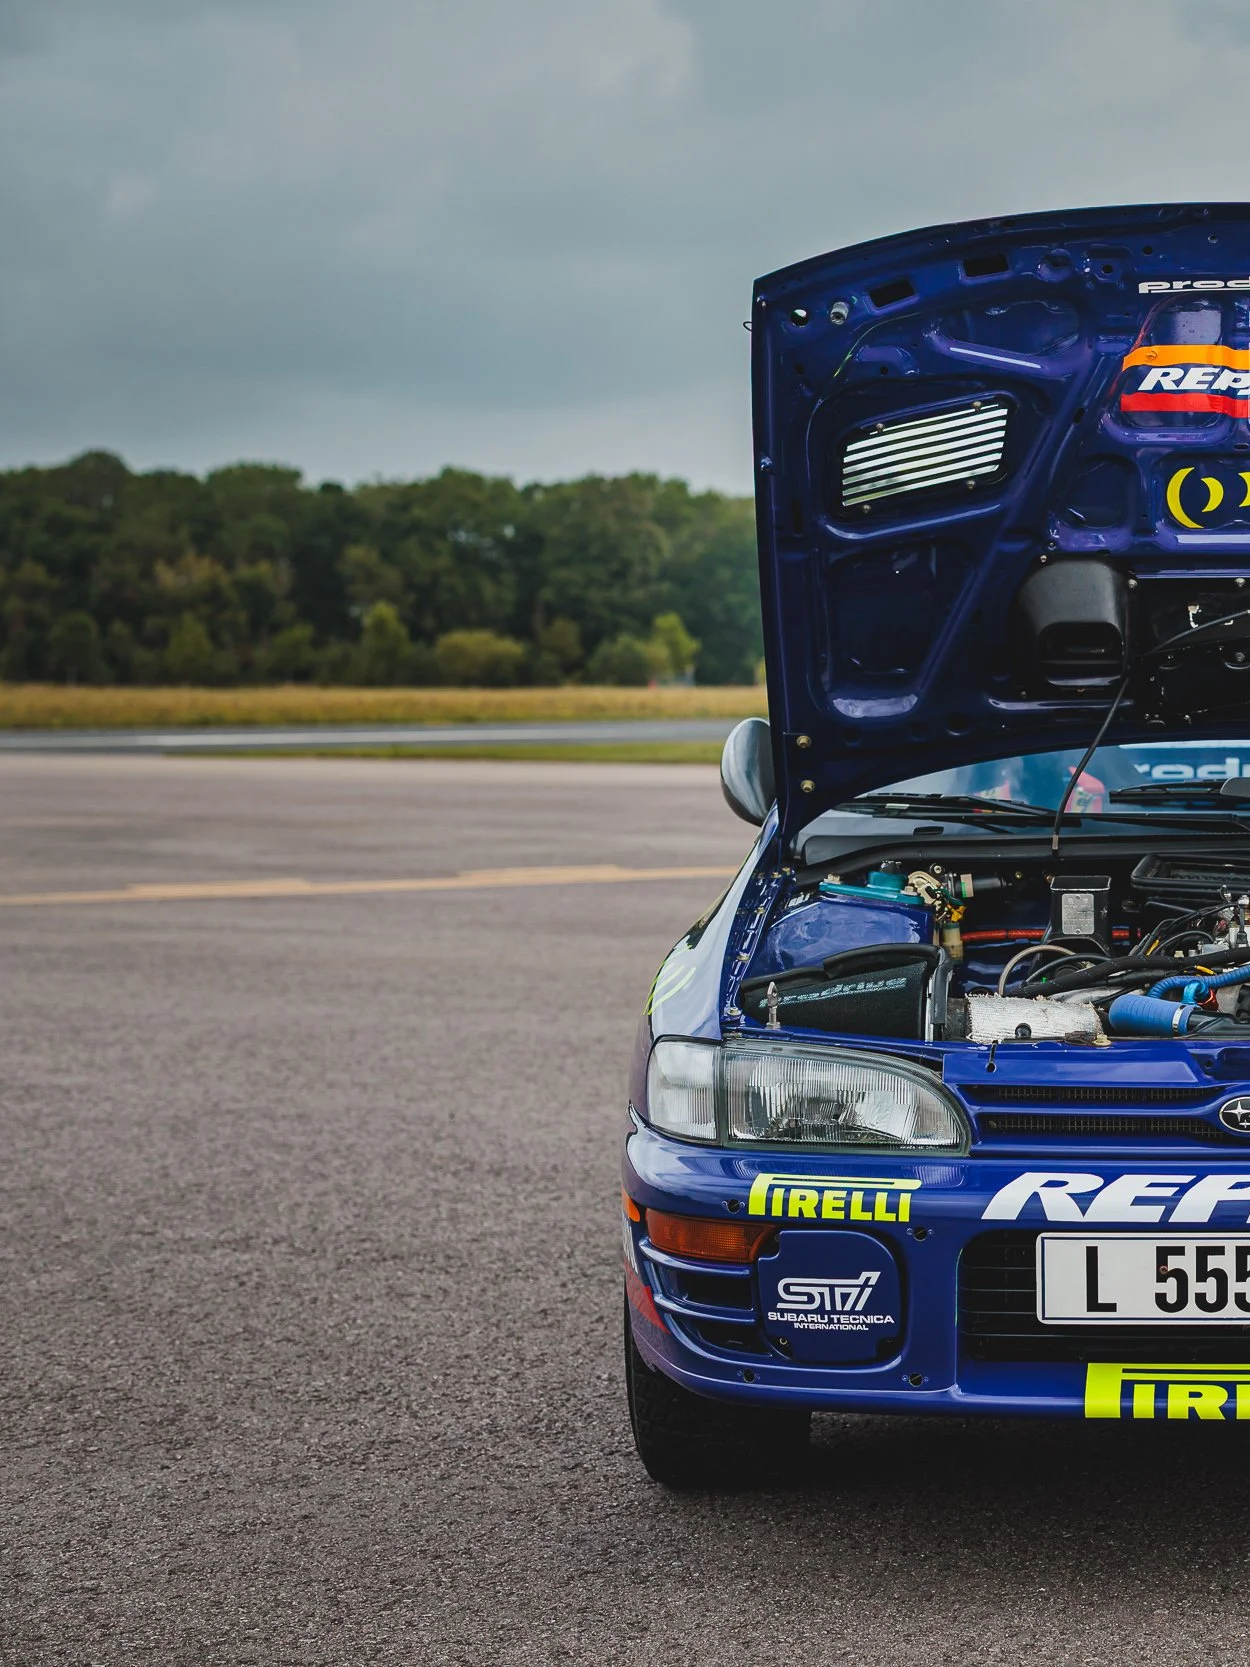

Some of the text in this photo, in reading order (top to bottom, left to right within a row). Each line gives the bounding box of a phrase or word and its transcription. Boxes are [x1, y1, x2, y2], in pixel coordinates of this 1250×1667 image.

[748, 1173, 922, 1222] PIRELLI
[1085, 1246, 1117, 1313] L
[767, 1311, 895, 1324] SUBARU TECNICA
[793, 1322, 869, 1331] INTERNATIONAL
